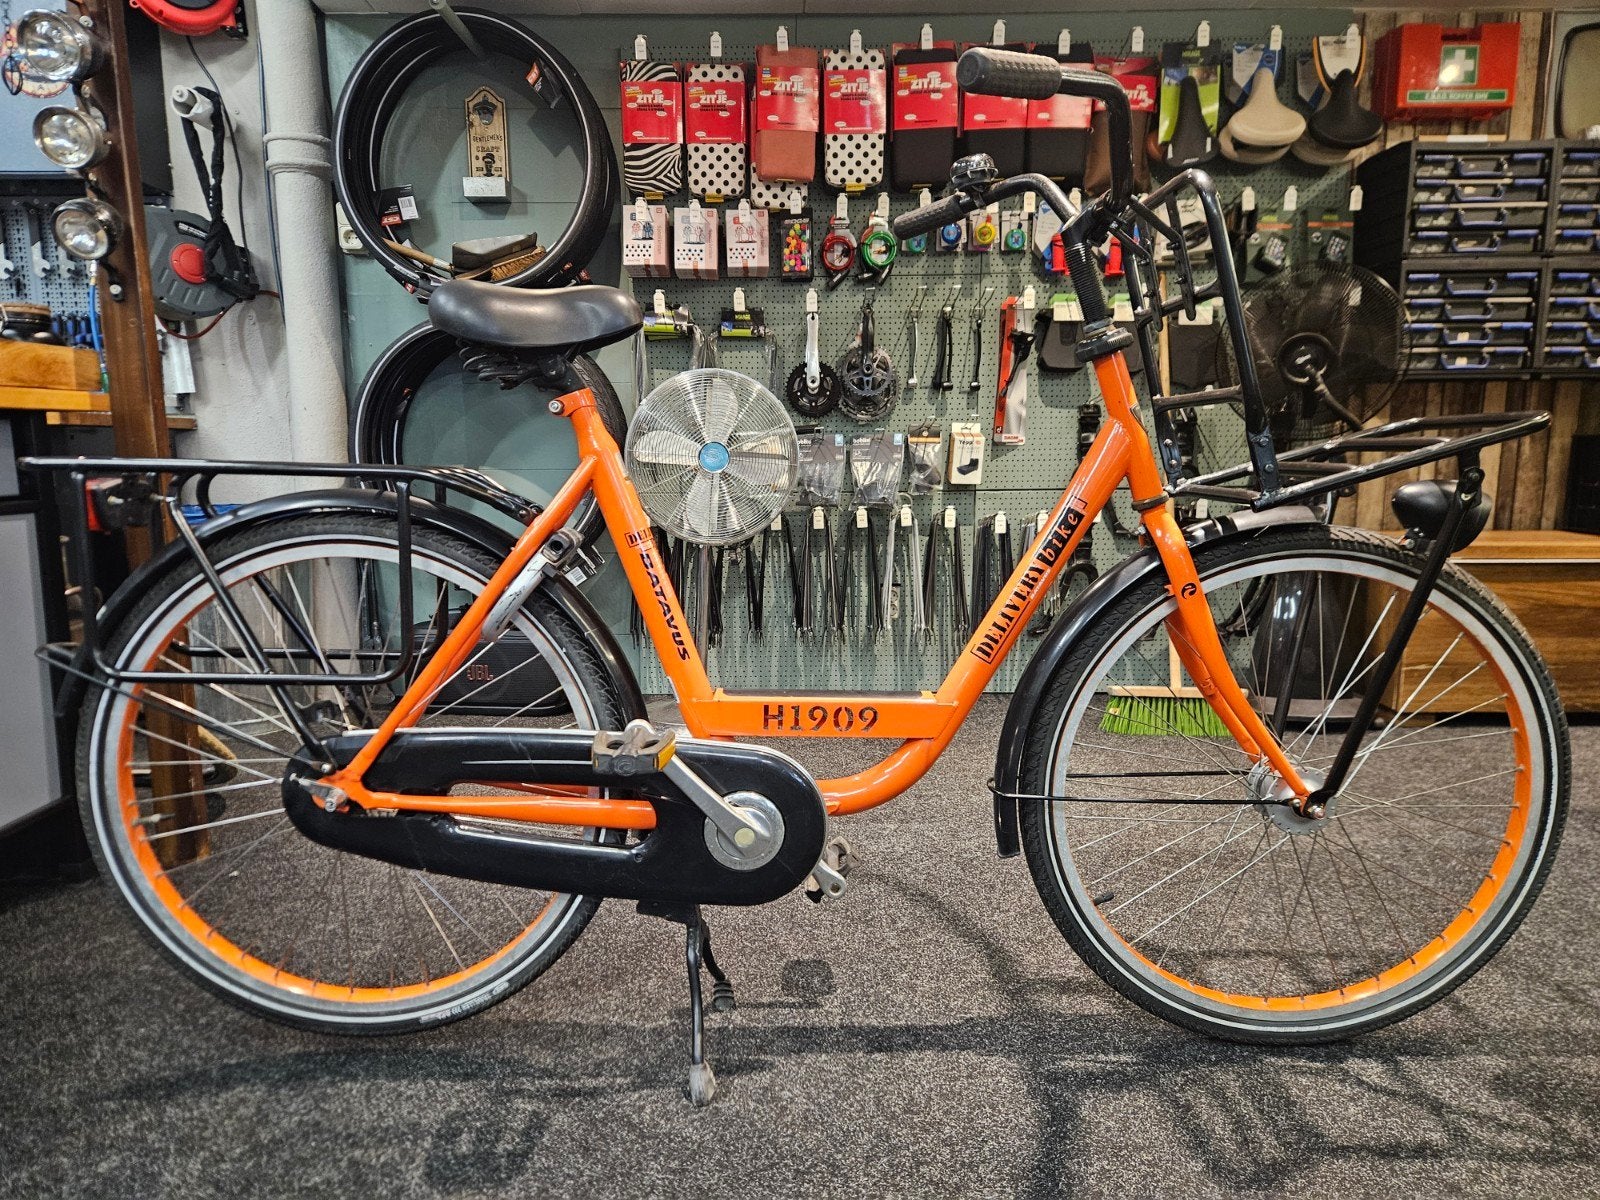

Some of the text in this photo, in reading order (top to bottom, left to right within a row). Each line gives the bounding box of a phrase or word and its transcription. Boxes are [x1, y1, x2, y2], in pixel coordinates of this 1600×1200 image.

[640, 553, 690, 661] BATAVUS
[976, 512, 1079, 658] DELIVERY bike
[467, 664, 494, 681] JBL
[763, 704, 879, 732] H1909
